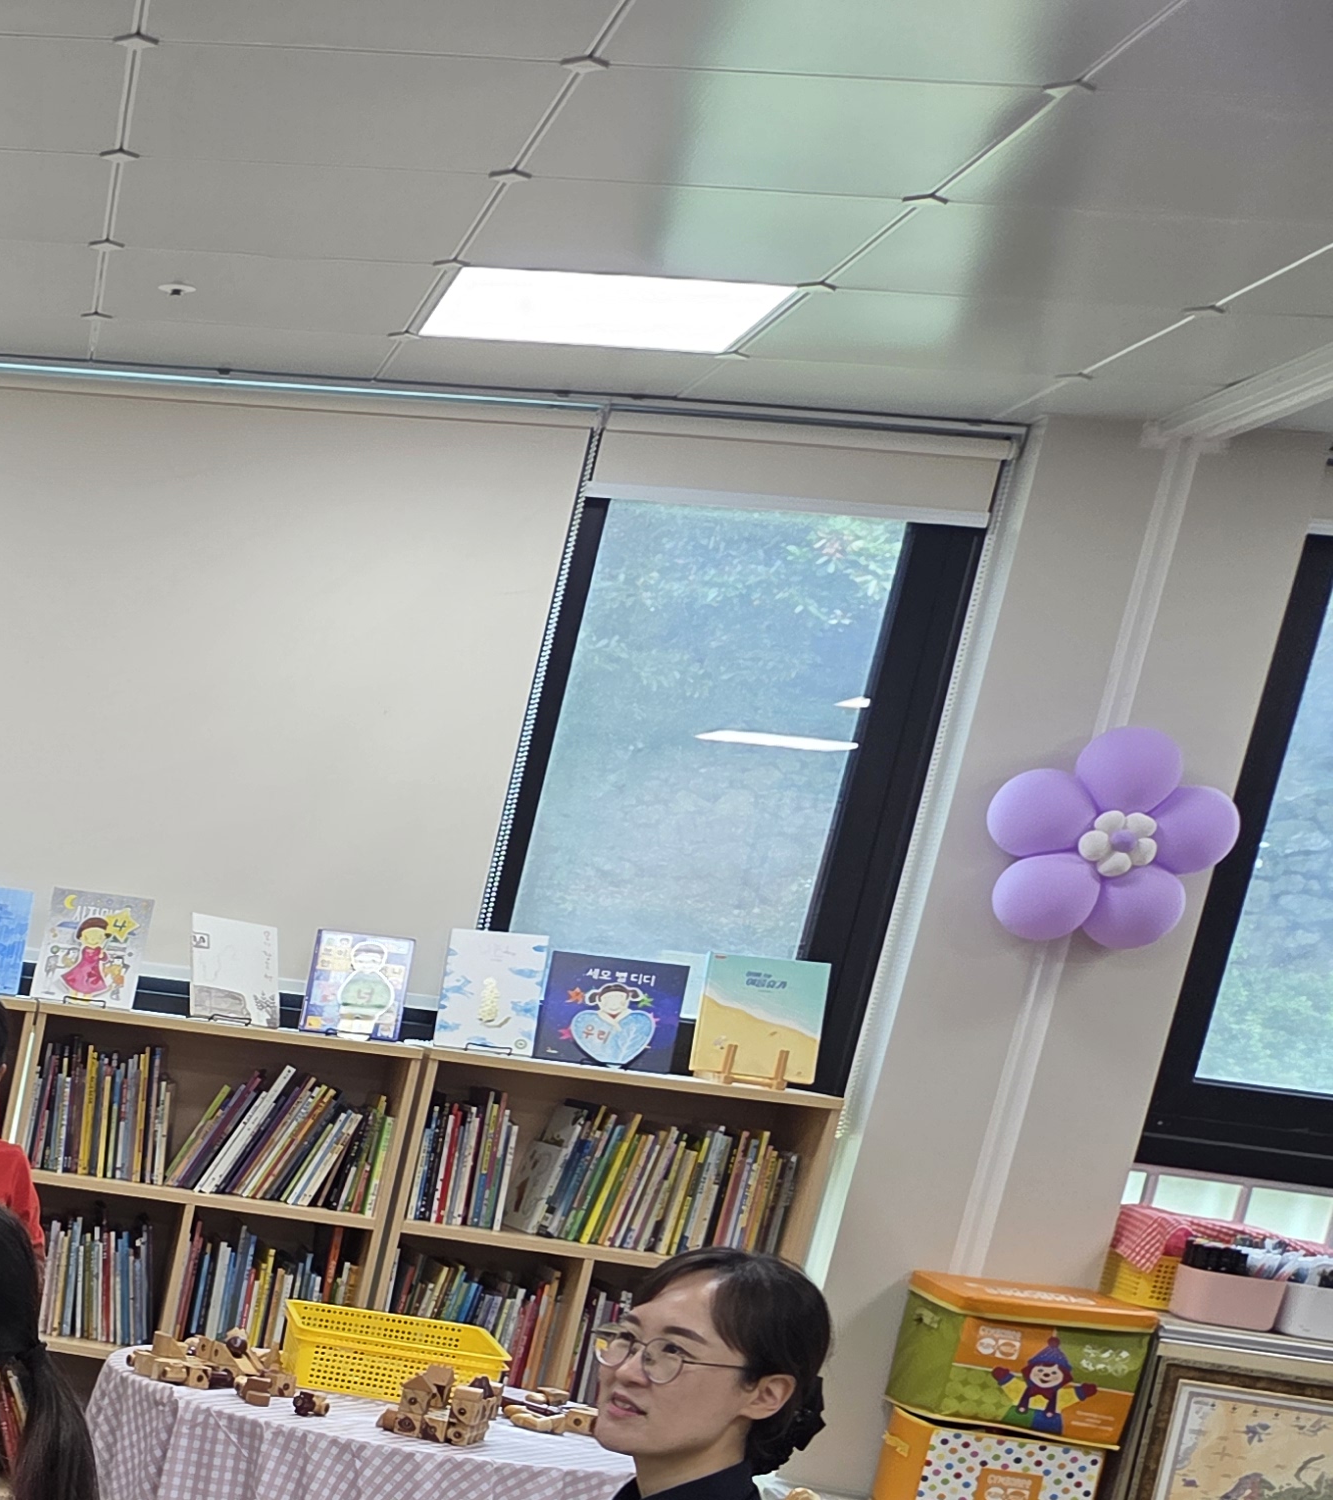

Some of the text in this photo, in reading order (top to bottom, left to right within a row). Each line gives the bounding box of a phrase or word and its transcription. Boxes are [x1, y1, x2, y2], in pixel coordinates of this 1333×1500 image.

[112, 918, 128, 932] 4
[630, 973, 657, 987] 디디
[583, 1024, 611, 1045] 우리
